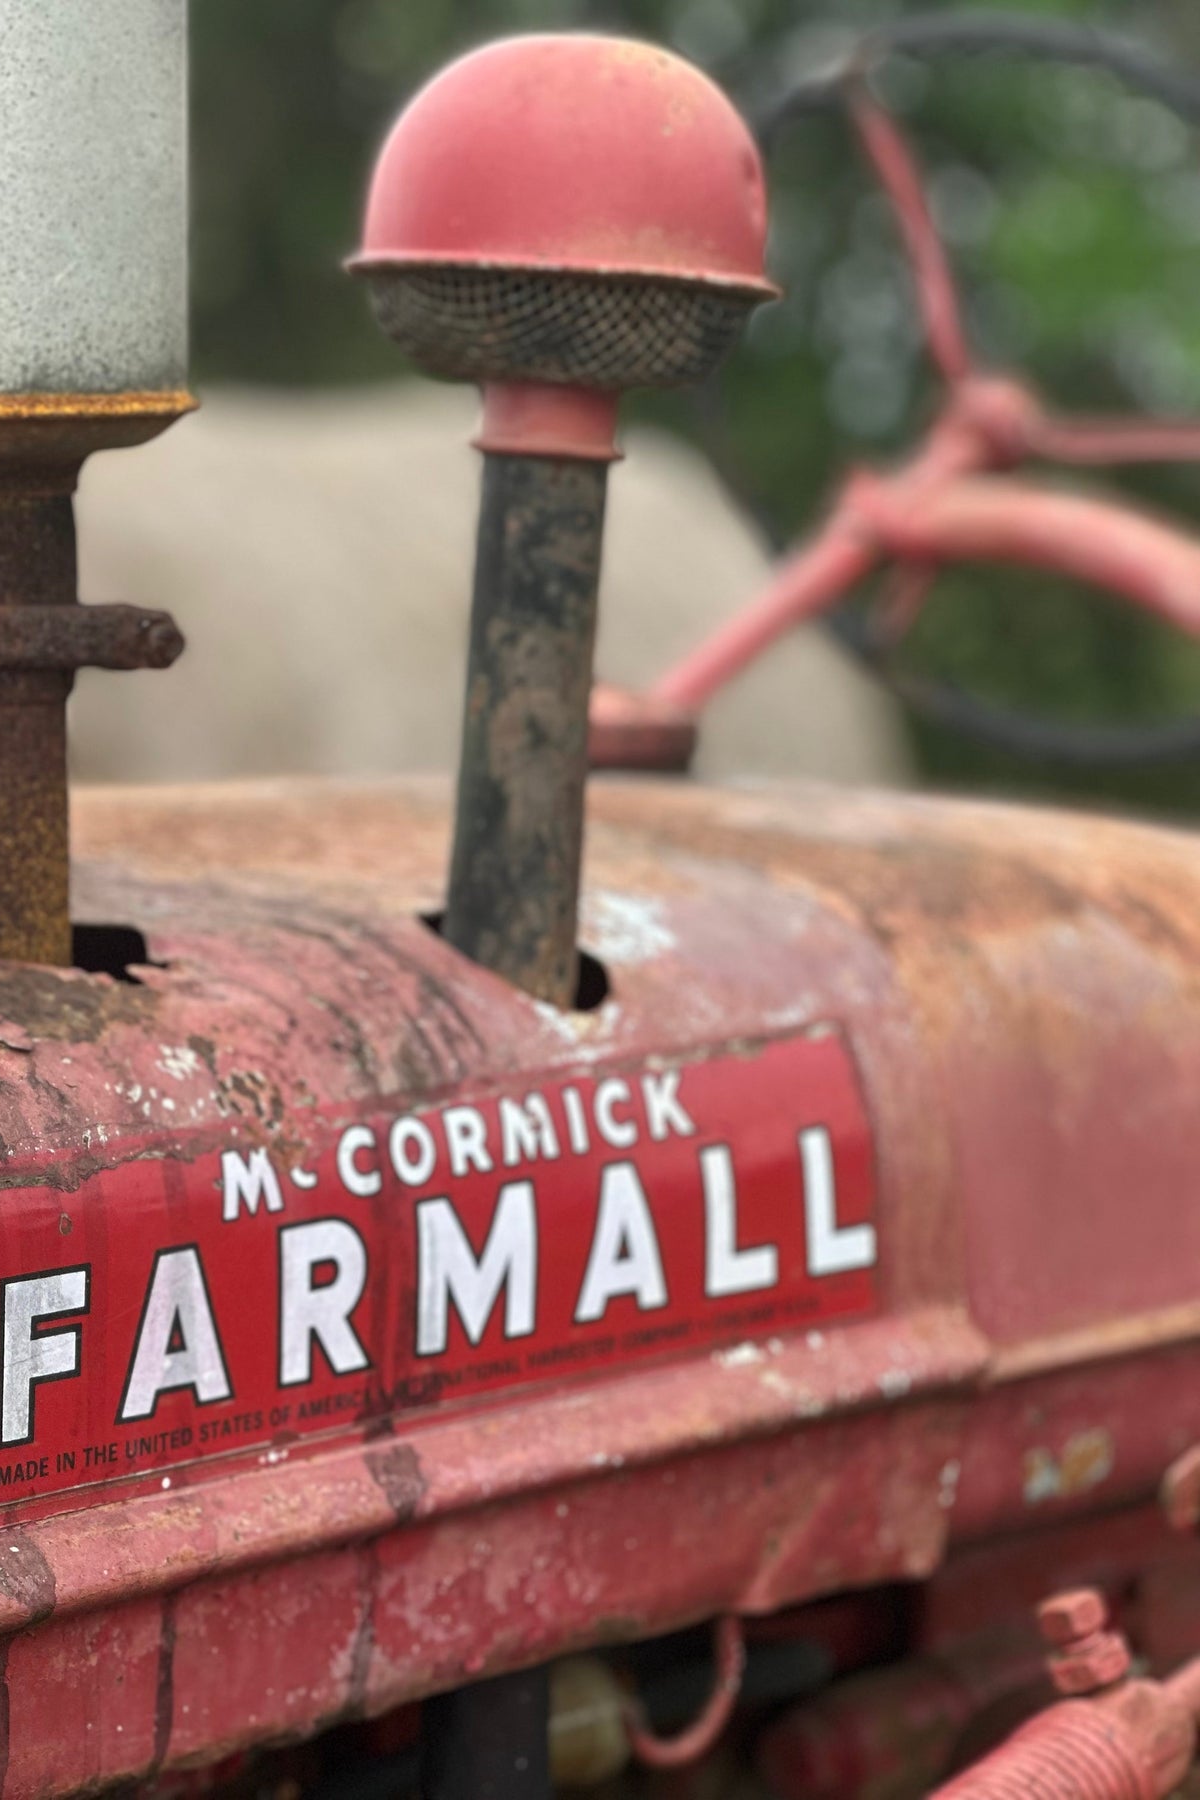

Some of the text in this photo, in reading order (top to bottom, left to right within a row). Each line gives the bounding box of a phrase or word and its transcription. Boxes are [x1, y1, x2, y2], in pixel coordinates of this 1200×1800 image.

[56, 1450, 76, 1472] IN
[83, 1442, 118, 1467] THE
[125, 1426, 193, 1459] UNITED
[200, 1412, 263, 1443] STATES
[269, 1406, 291, 1427] OF
[297, 1385, 373, 1420] AMERICA
